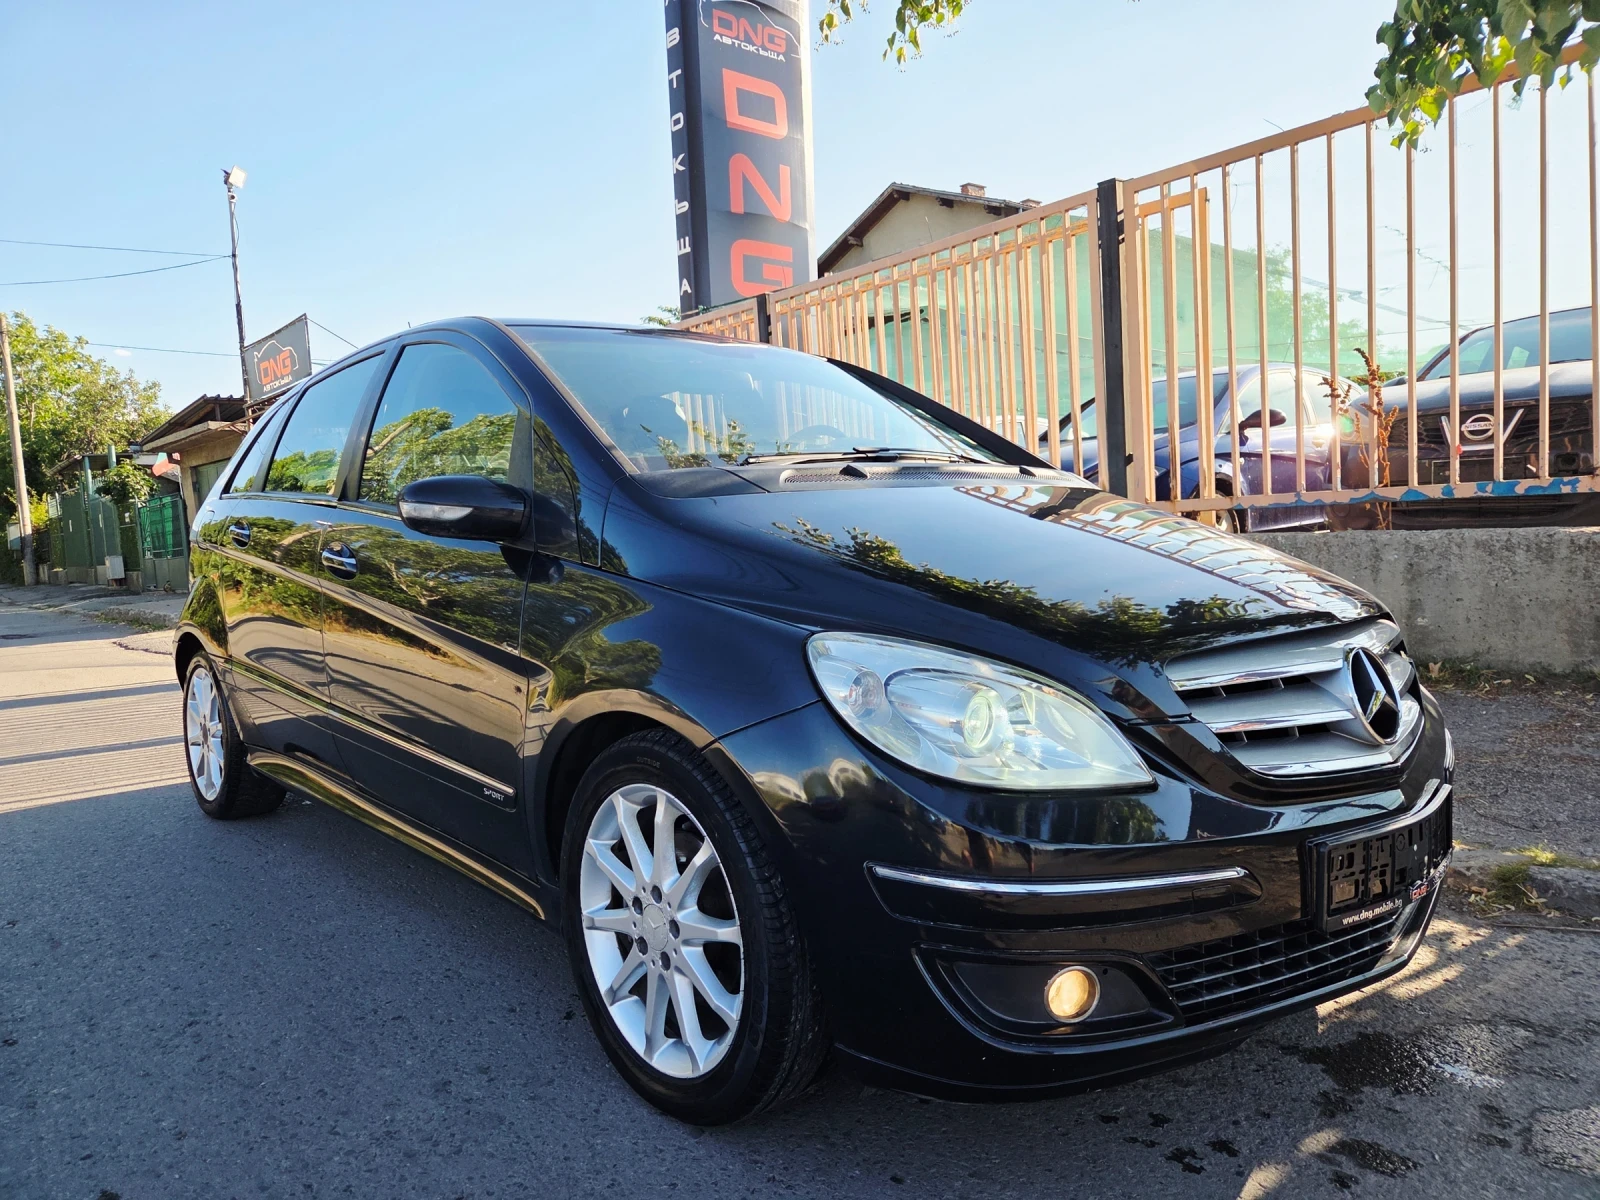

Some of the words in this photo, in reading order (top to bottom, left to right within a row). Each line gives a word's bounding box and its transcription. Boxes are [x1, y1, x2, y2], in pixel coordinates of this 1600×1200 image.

[712, 8, 787, 53] DNG
[713, 33, 786, 62] АВТОКЪЩА
[665, 0, 692, 296] ВТОКЪЩА
[722, 68, 793, 298] DNG
[260, 349, 292, 385] DNG
[1464, 421, 1495, 429] NISSAN
[483, 787, 505, 801] SPORT
[1412, 884, 1429, 900] DNG
[1342, 898, 1403, 925] www.dng.mobile.bg
